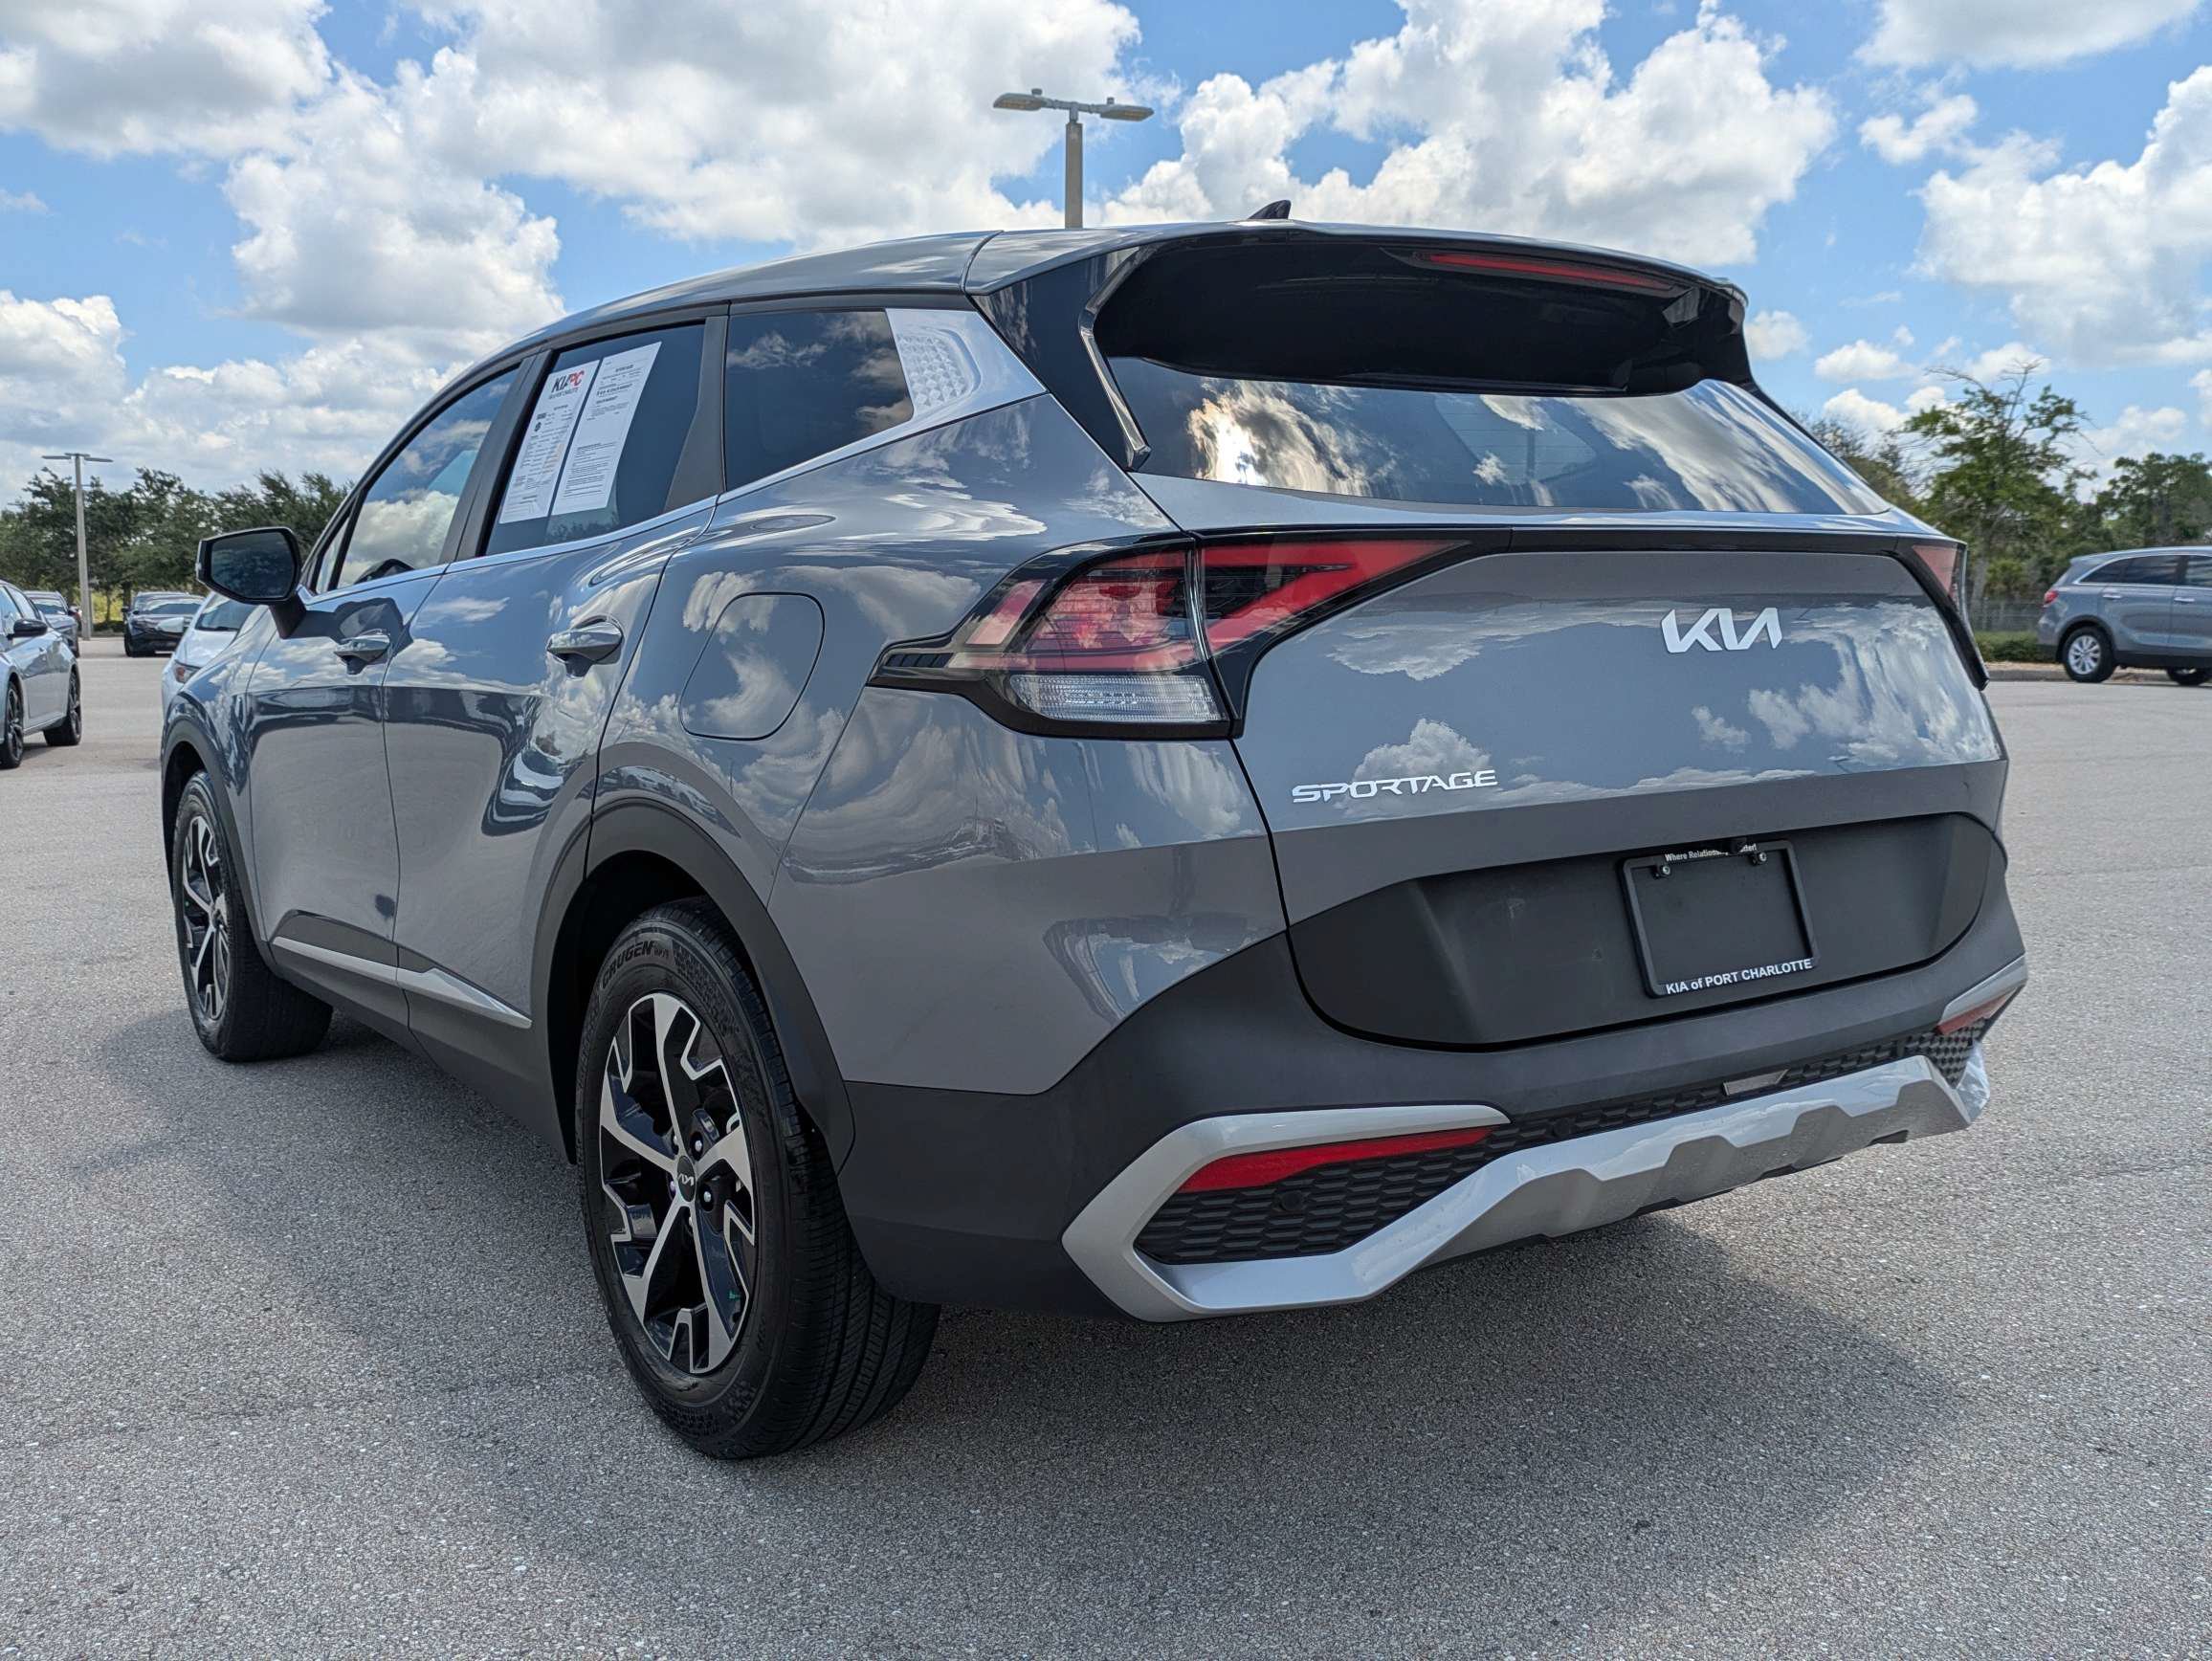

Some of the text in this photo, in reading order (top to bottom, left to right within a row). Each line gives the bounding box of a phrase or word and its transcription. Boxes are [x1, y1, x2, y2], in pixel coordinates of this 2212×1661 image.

[1660, 608, 1782, 654] KIA
[1292, 768, 1498, 804] SPORTAGE
[1665, 851, 1688, 862] Where
[1666, 958, 1813, 995] KIA of PORT CHARLOTTE
